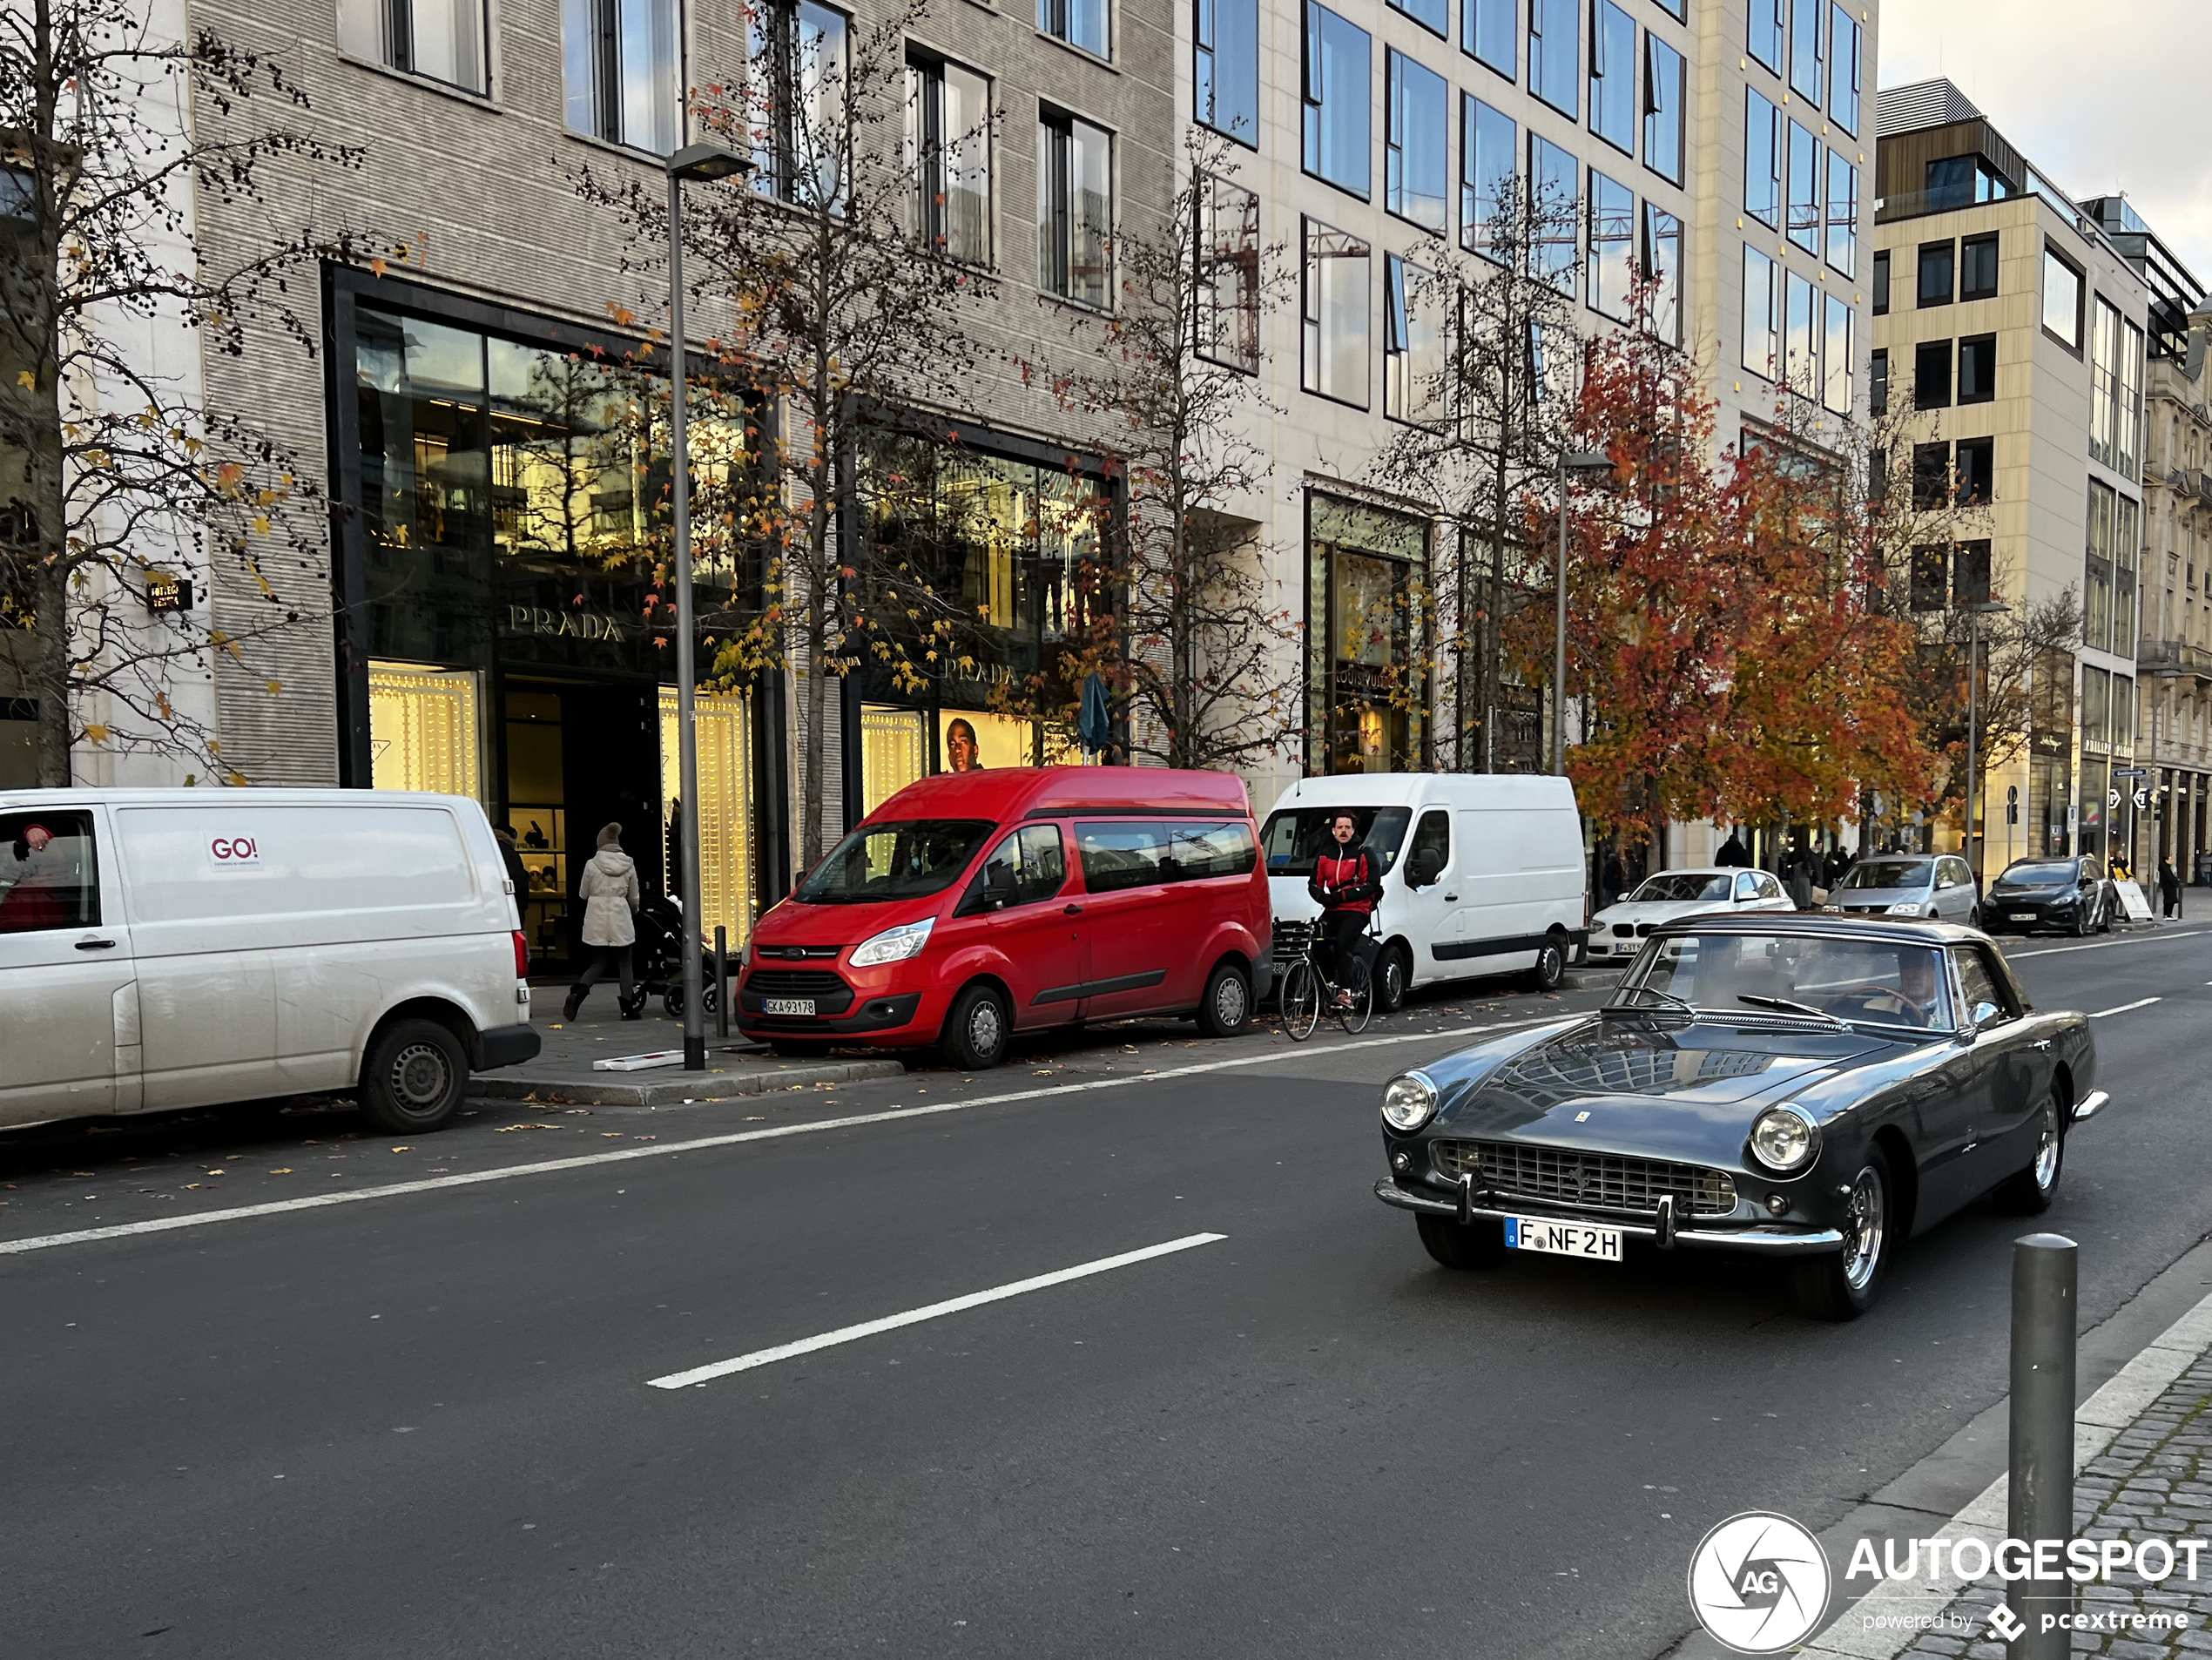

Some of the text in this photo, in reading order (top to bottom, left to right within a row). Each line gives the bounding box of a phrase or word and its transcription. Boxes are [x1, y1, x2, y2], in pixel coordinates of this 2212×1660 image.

[509, 604, 625, 643] PRADA
[212, 838, 258, 859] GO!
[1521, 1223, 1534, 1245] F
[1549, 1226, 1578, 1251] NF
